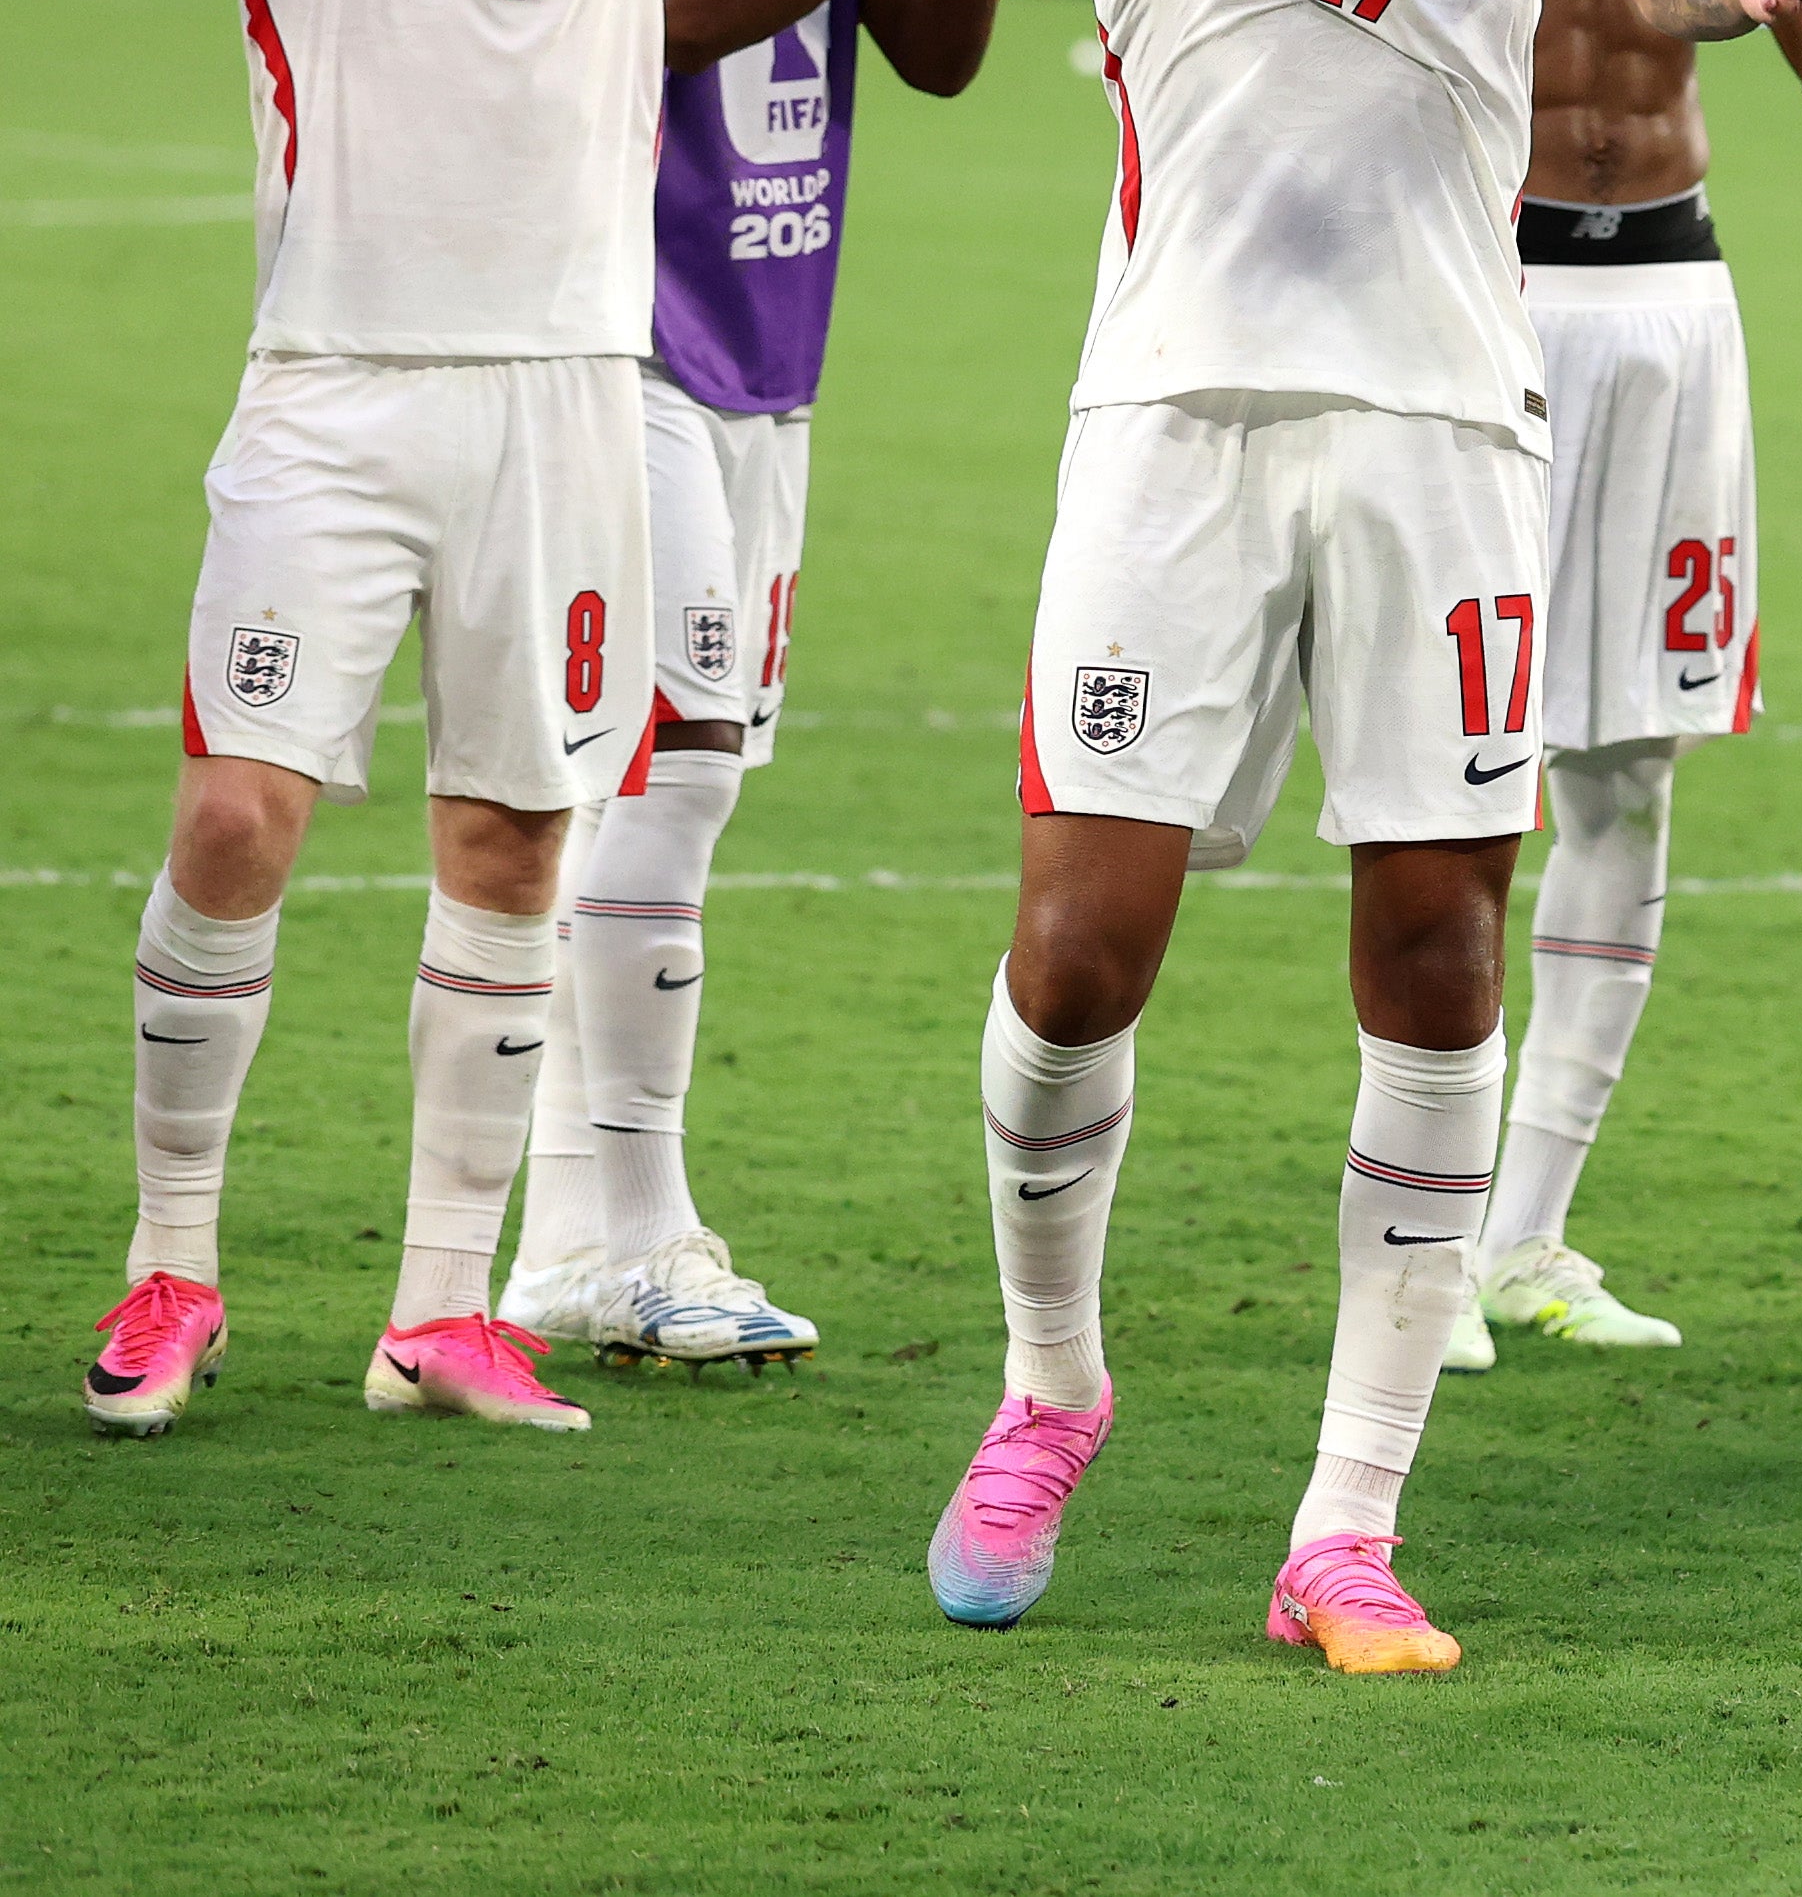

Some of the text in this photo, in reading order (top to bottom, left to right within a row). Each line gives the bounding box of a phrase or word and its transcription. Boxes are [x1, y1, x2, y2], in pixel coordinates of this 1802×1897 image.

[565, 589, 607, 714] 8
[1664, 535, 1735, 653] 25
[1445, 592, 1535, 737] 17
